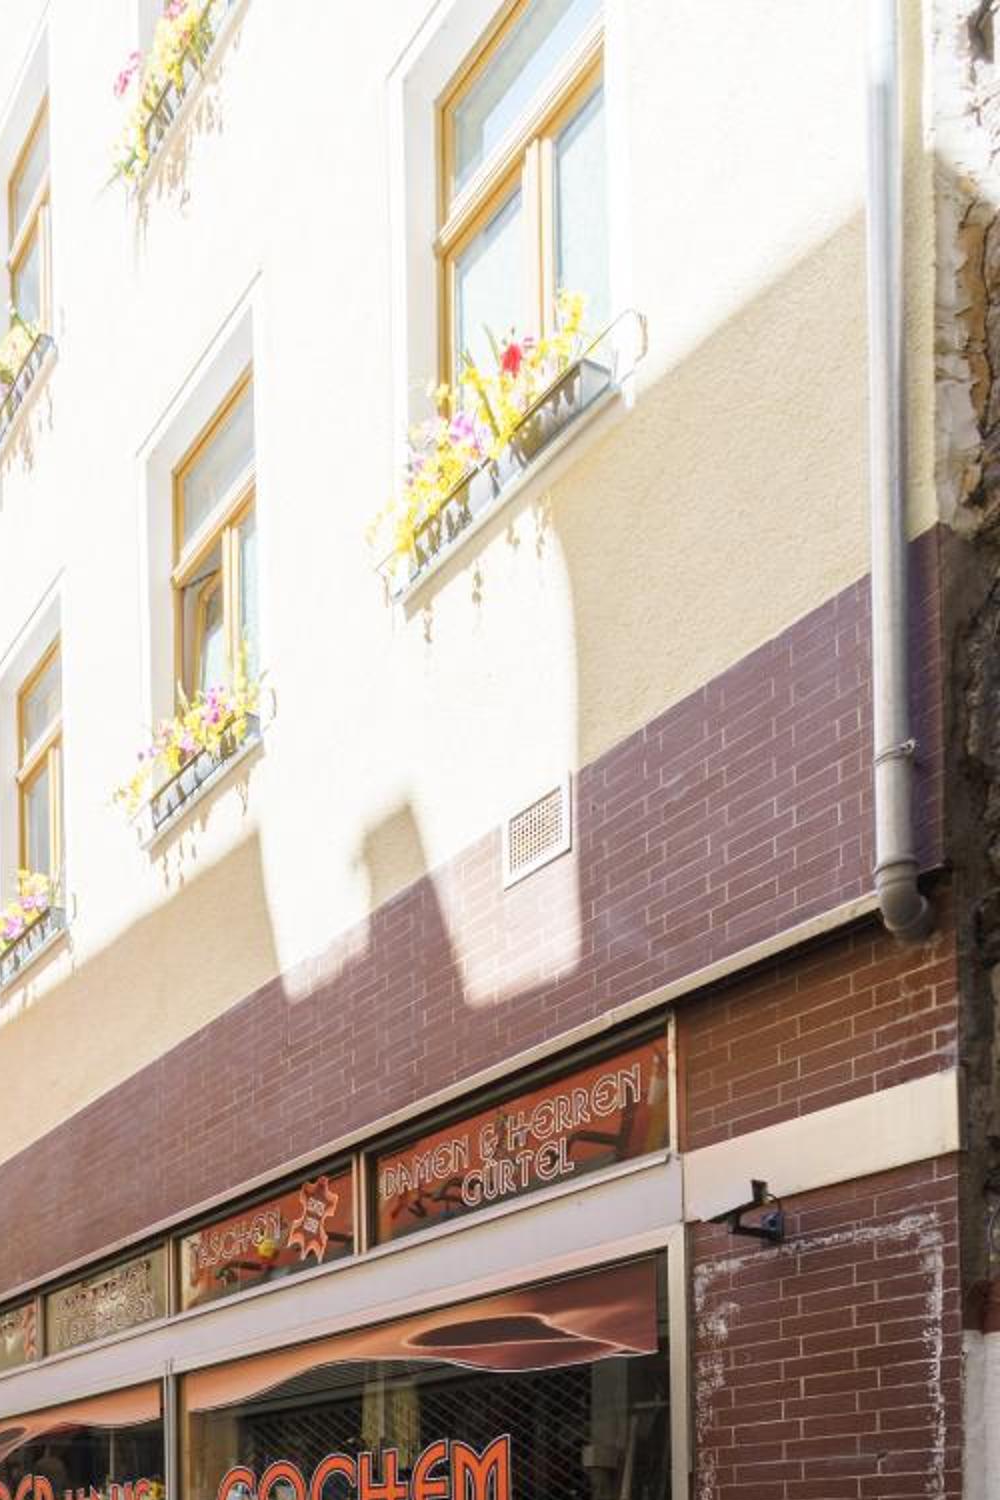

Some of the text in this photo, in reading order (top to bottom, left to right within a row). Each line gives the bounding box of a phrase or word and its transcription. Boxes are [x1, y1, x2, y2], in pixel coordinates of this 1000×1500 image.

[379, 1135, 470, 1200] DAMEN
[506, 1063, 641, 1151] HERREN
[461, 1136, 575, 1207] GÜRTEL
